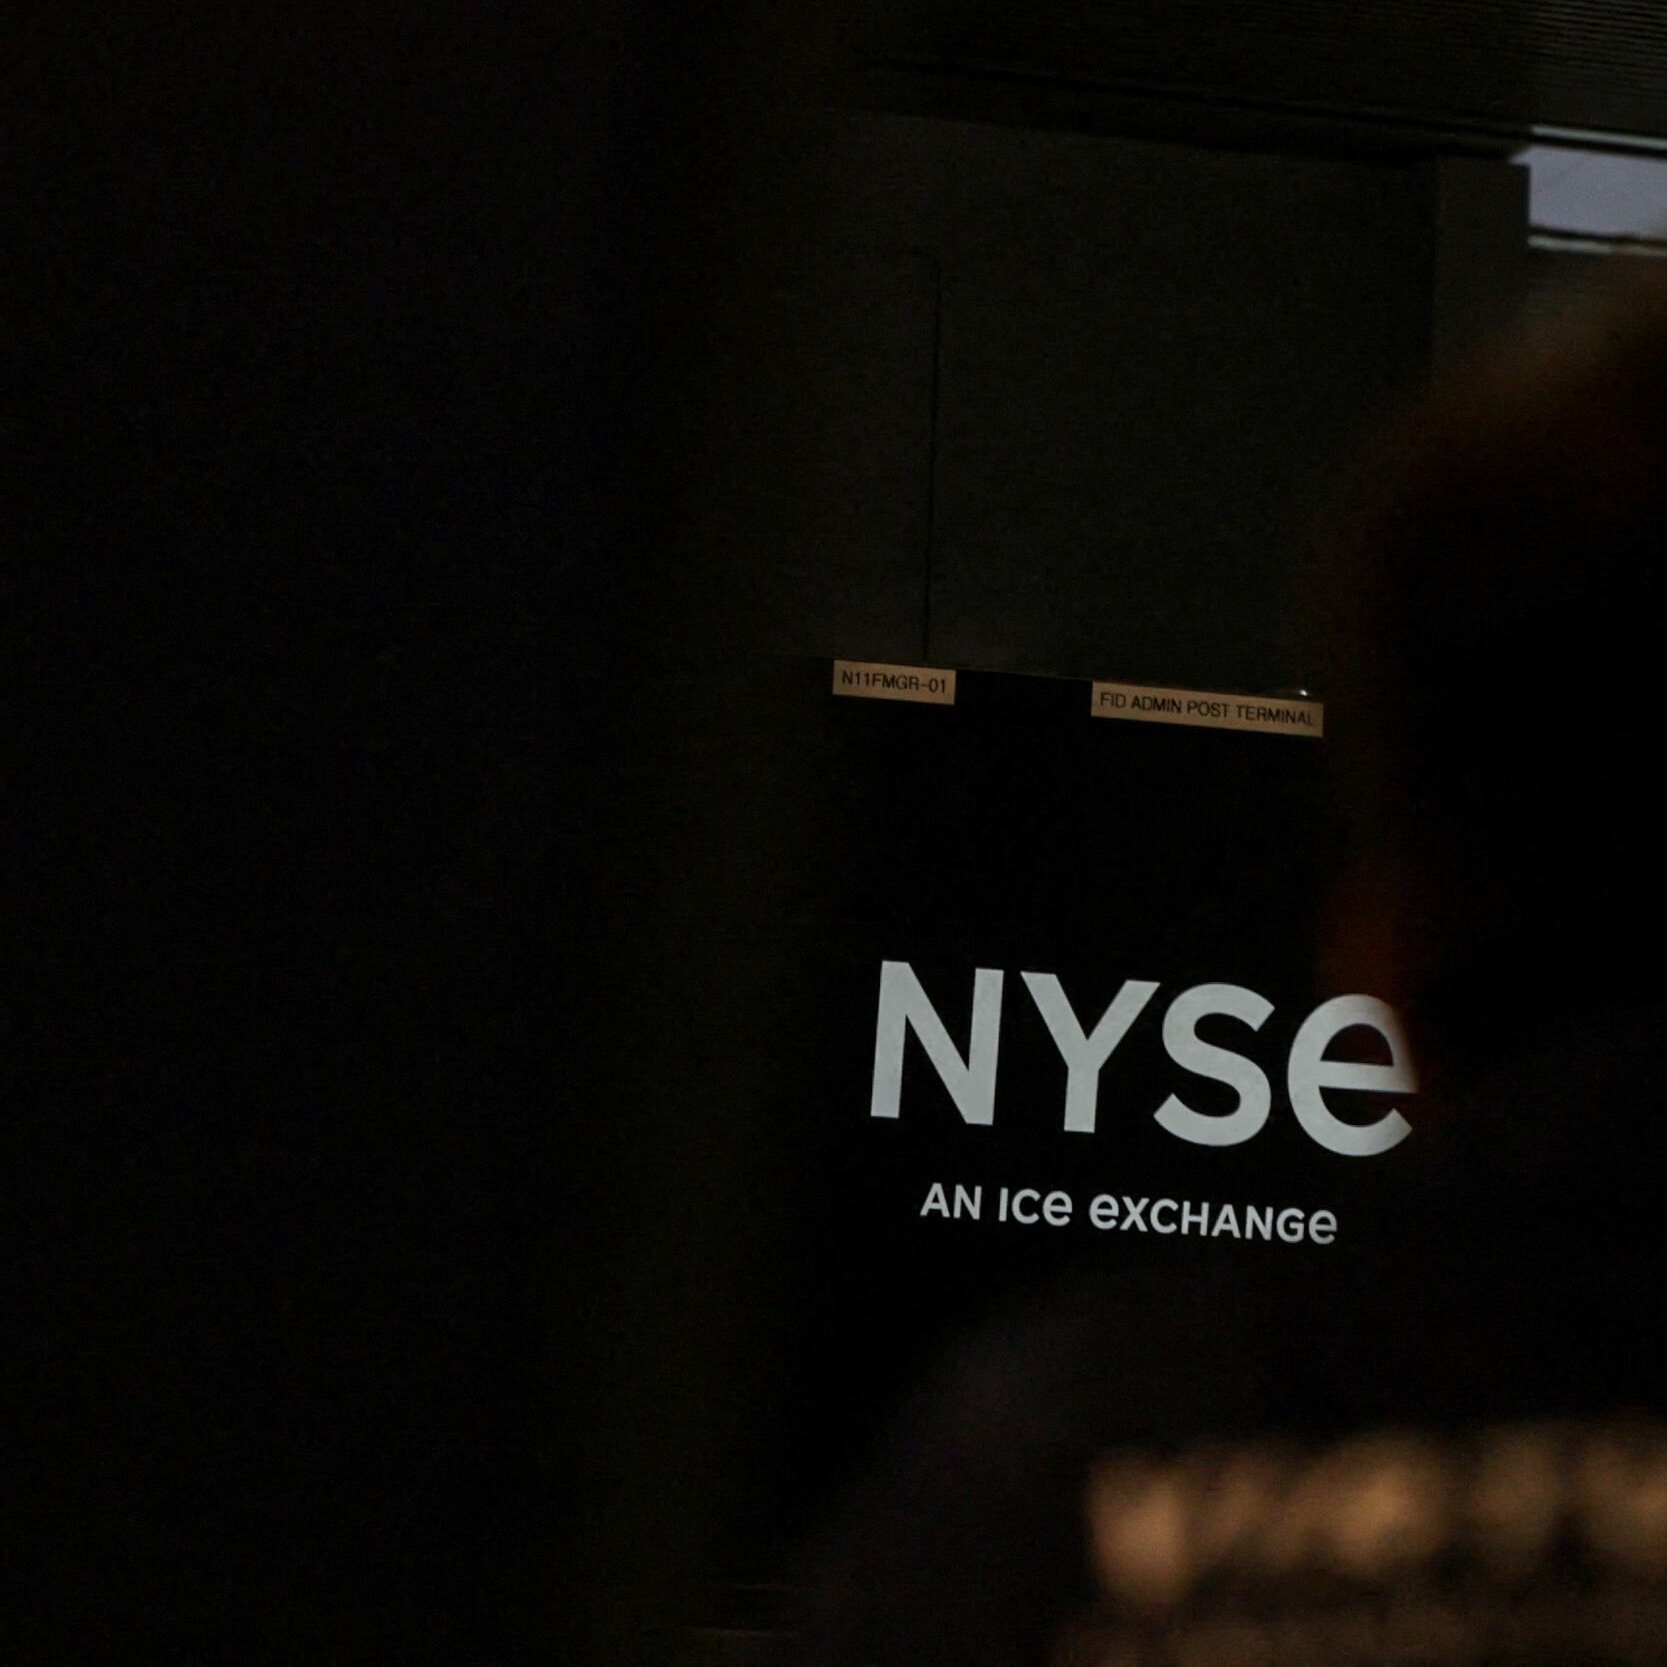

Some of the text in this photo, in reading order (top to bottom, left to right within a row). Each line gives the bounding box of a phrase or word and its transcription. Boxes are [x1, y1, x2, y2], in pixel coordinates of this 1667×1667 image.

[842, 670, 946, 694] N11FMGR-01
[1100, 692, 1317, 726] FID ADMIN POST TERMINAL
[919, 1180, 983, 1222] AN
